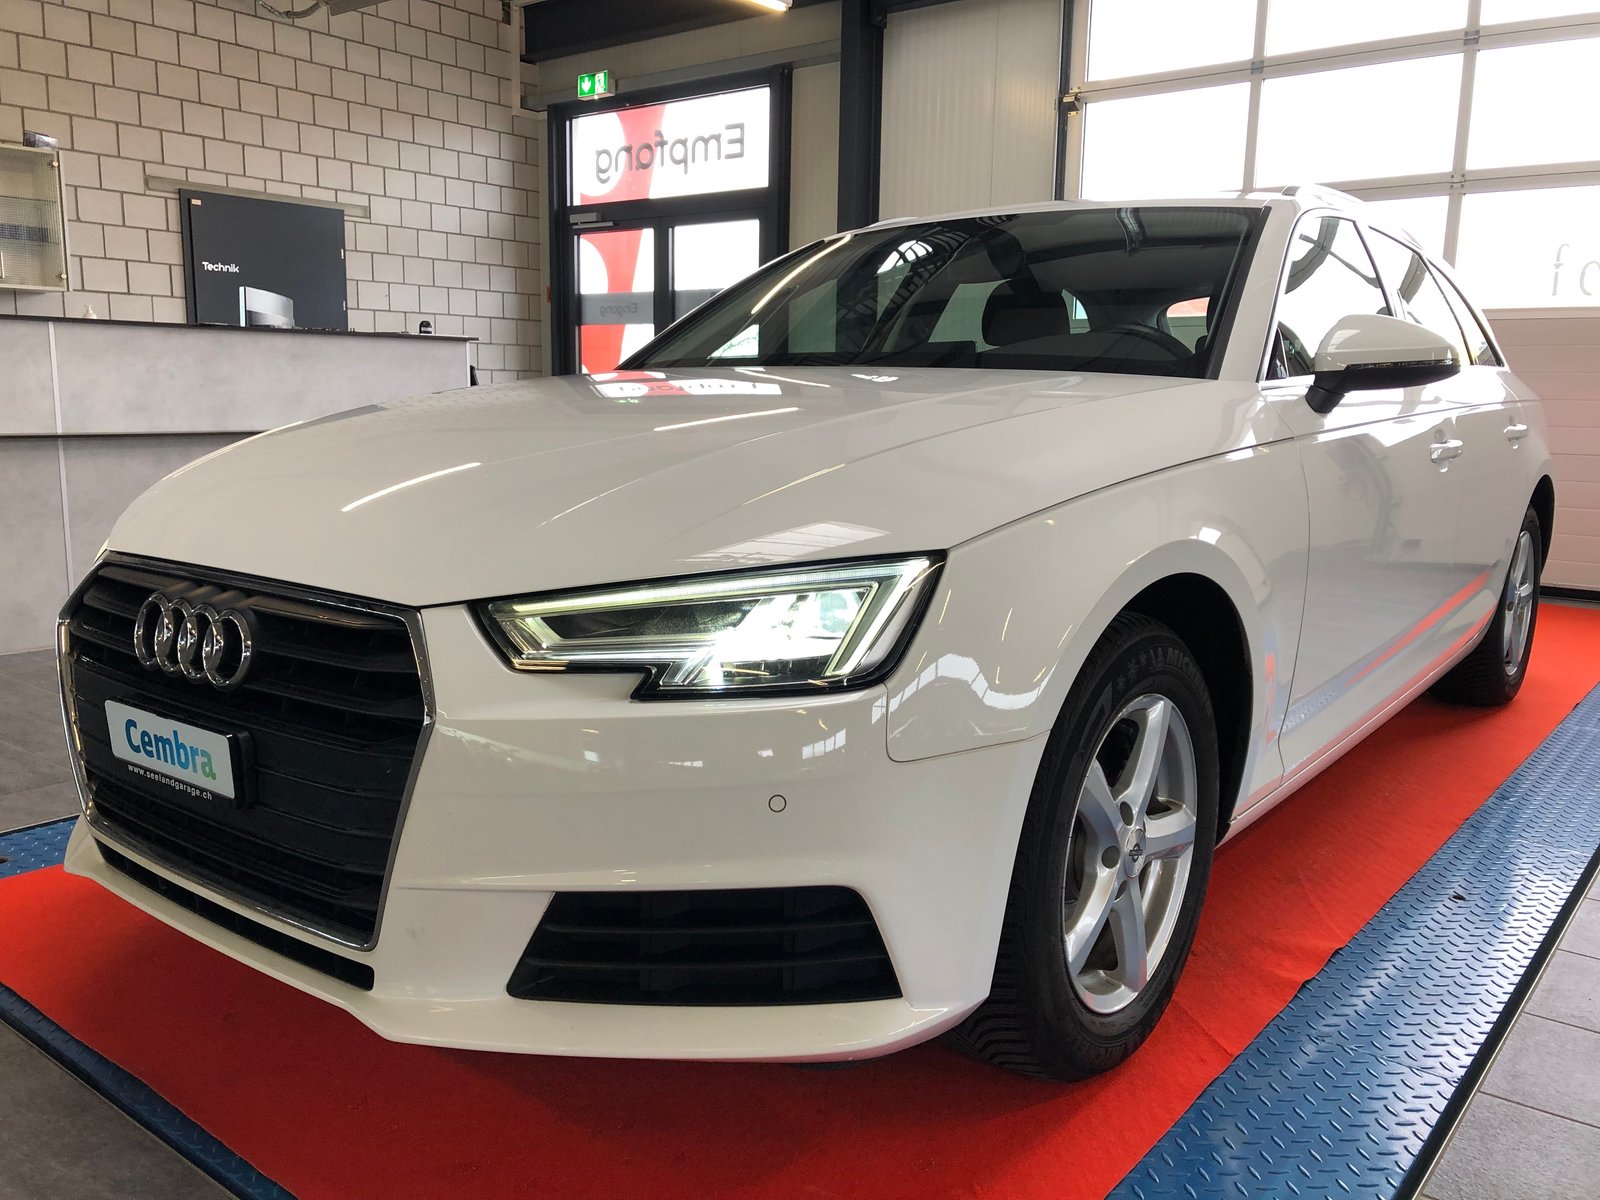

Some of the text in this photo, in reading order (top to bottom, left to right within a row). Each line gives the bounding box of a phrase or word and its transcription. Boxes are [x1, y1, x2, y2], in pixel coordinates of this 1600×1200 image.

[202, 261, 240, 274] Technik
[125, 718, 217, 781] Cembra
[127, 764, 213, 802] www.seelandgarage.ch
